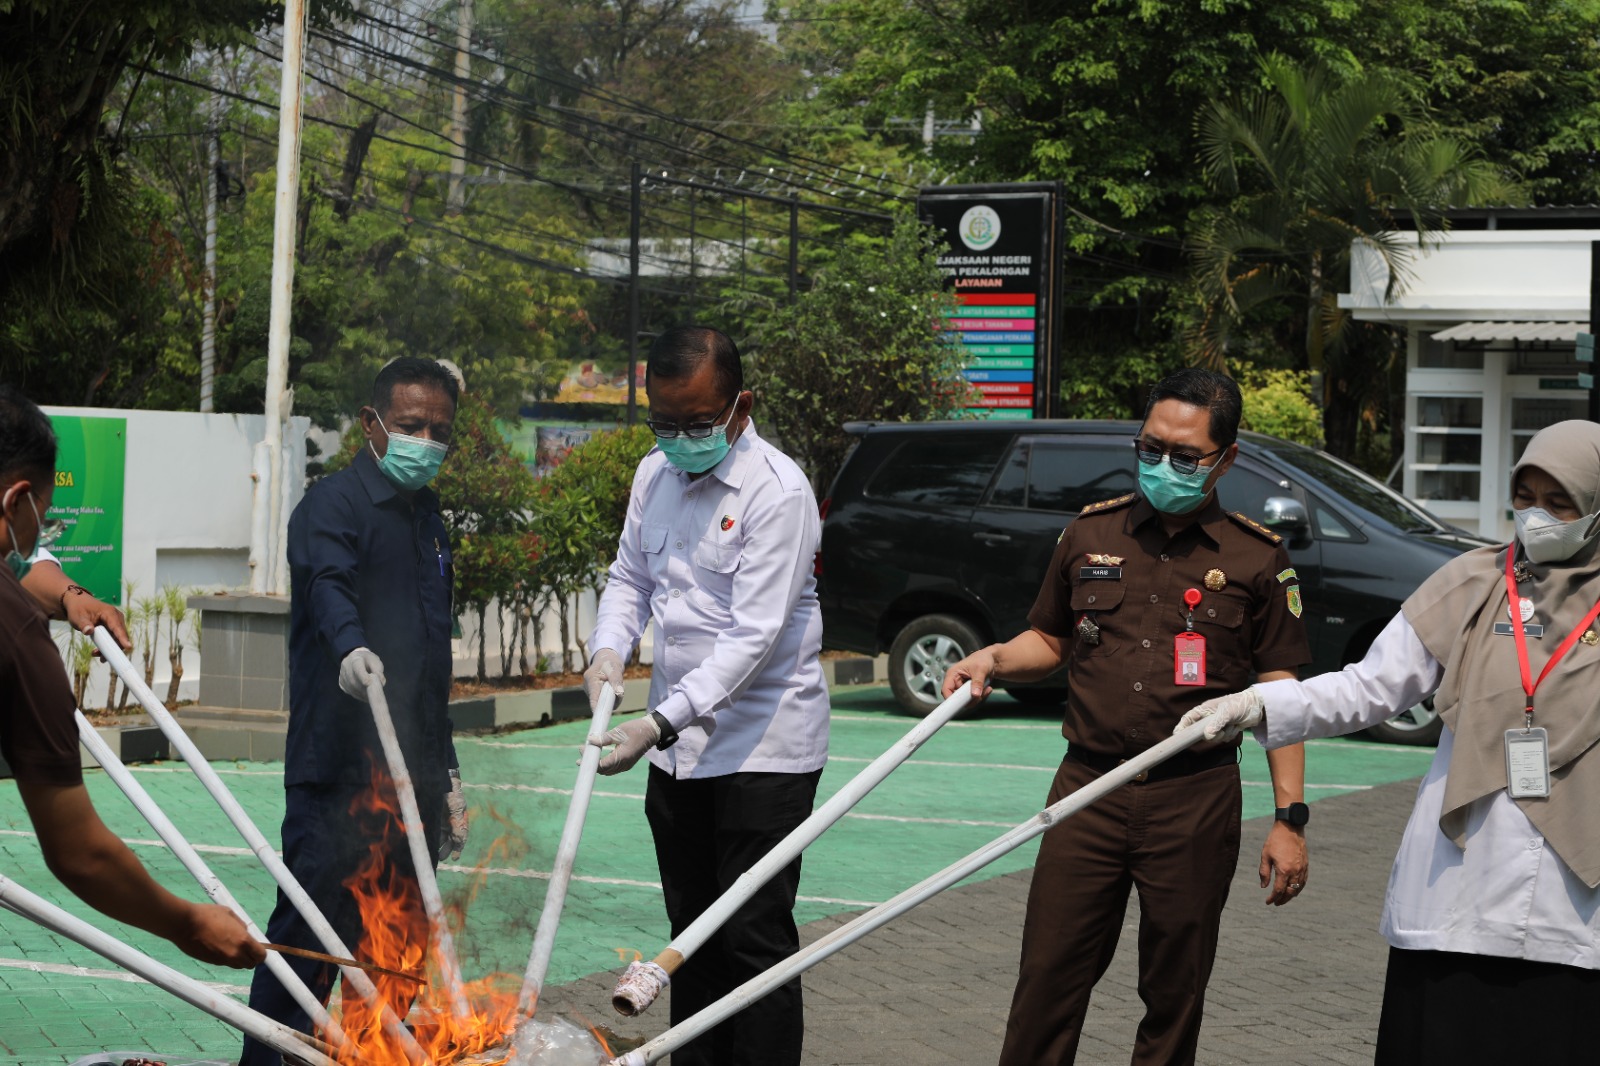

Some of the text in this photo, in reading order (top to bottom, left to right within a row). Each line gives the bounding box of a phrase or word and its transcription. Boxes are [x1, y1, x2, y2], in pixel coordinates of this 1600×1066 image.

[936, 256, 1031, 265] EJAKSAAN NEGERI
[959, 267, 1030, 276] PEKALONGAN
[955, 279, 1003, 287] LAYANAN
[55, 472, 74, 487] KSA
[66, 506, 79, 515] Yang
[75, 545, 99, 553] tanggung
[99, 544, 113, 552] jawab
